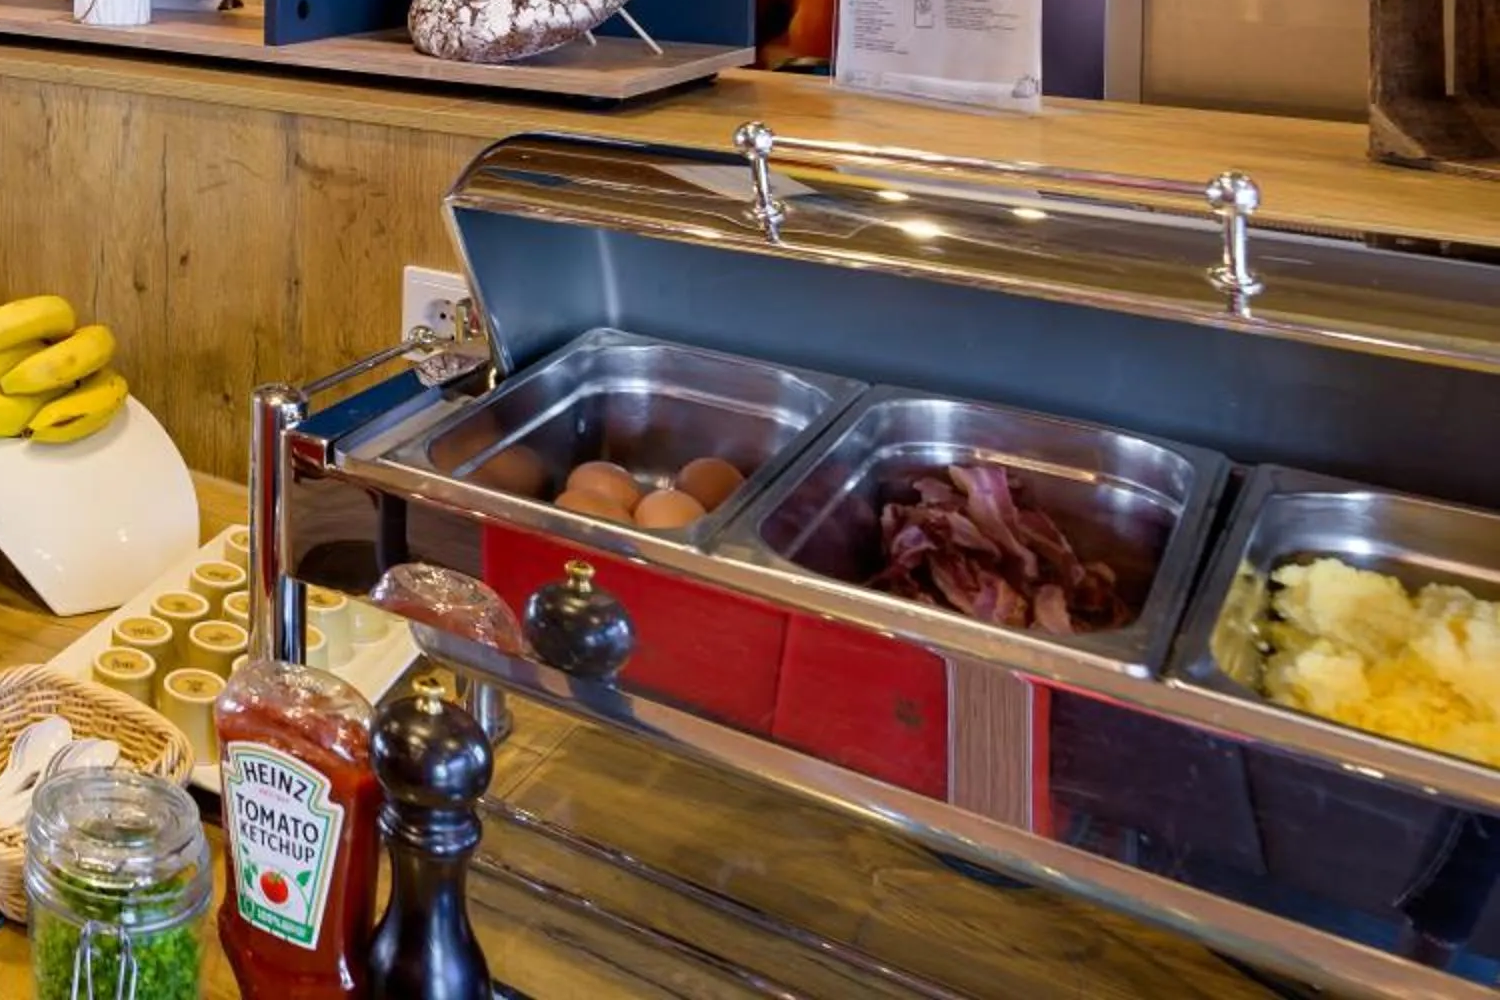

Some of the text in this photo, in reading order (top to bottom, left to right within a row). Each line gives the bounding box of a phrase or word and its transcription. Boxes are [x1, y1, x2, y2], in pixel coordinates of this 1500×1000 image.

[243, 761, 308, 802] HEINZ
[235, 793, 319, 843] TOMATO
[240, 822, 315, 863] KETCHUP
